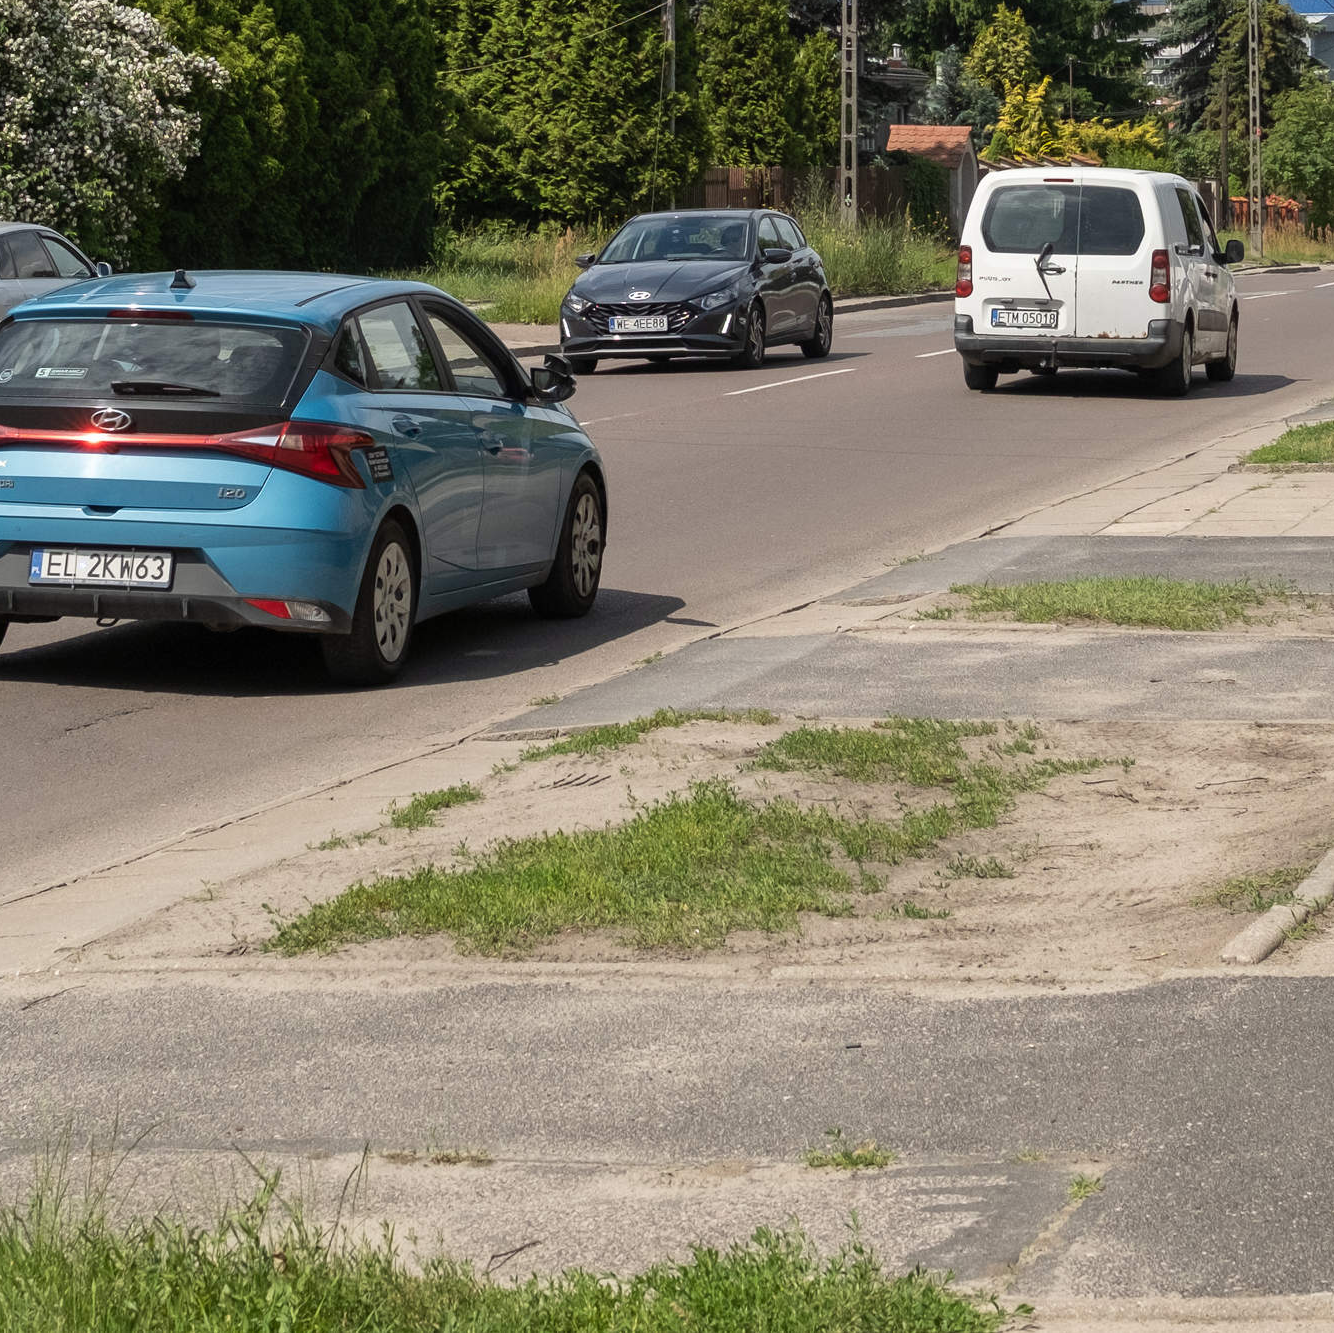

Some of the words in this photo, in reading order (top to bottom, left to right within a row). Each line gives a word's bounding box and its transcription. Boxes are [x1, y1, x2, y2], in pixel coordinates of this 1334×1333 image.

[617, 319, 629, 329] WE
[634, 318, 665, 329] 4EE88
[998, 312, 1019, 323] ETM
[1022, 313, 1056, 324] 05018
[47, 552, 75, 577] EL
[87, 553, 165, 580] 2KW63
